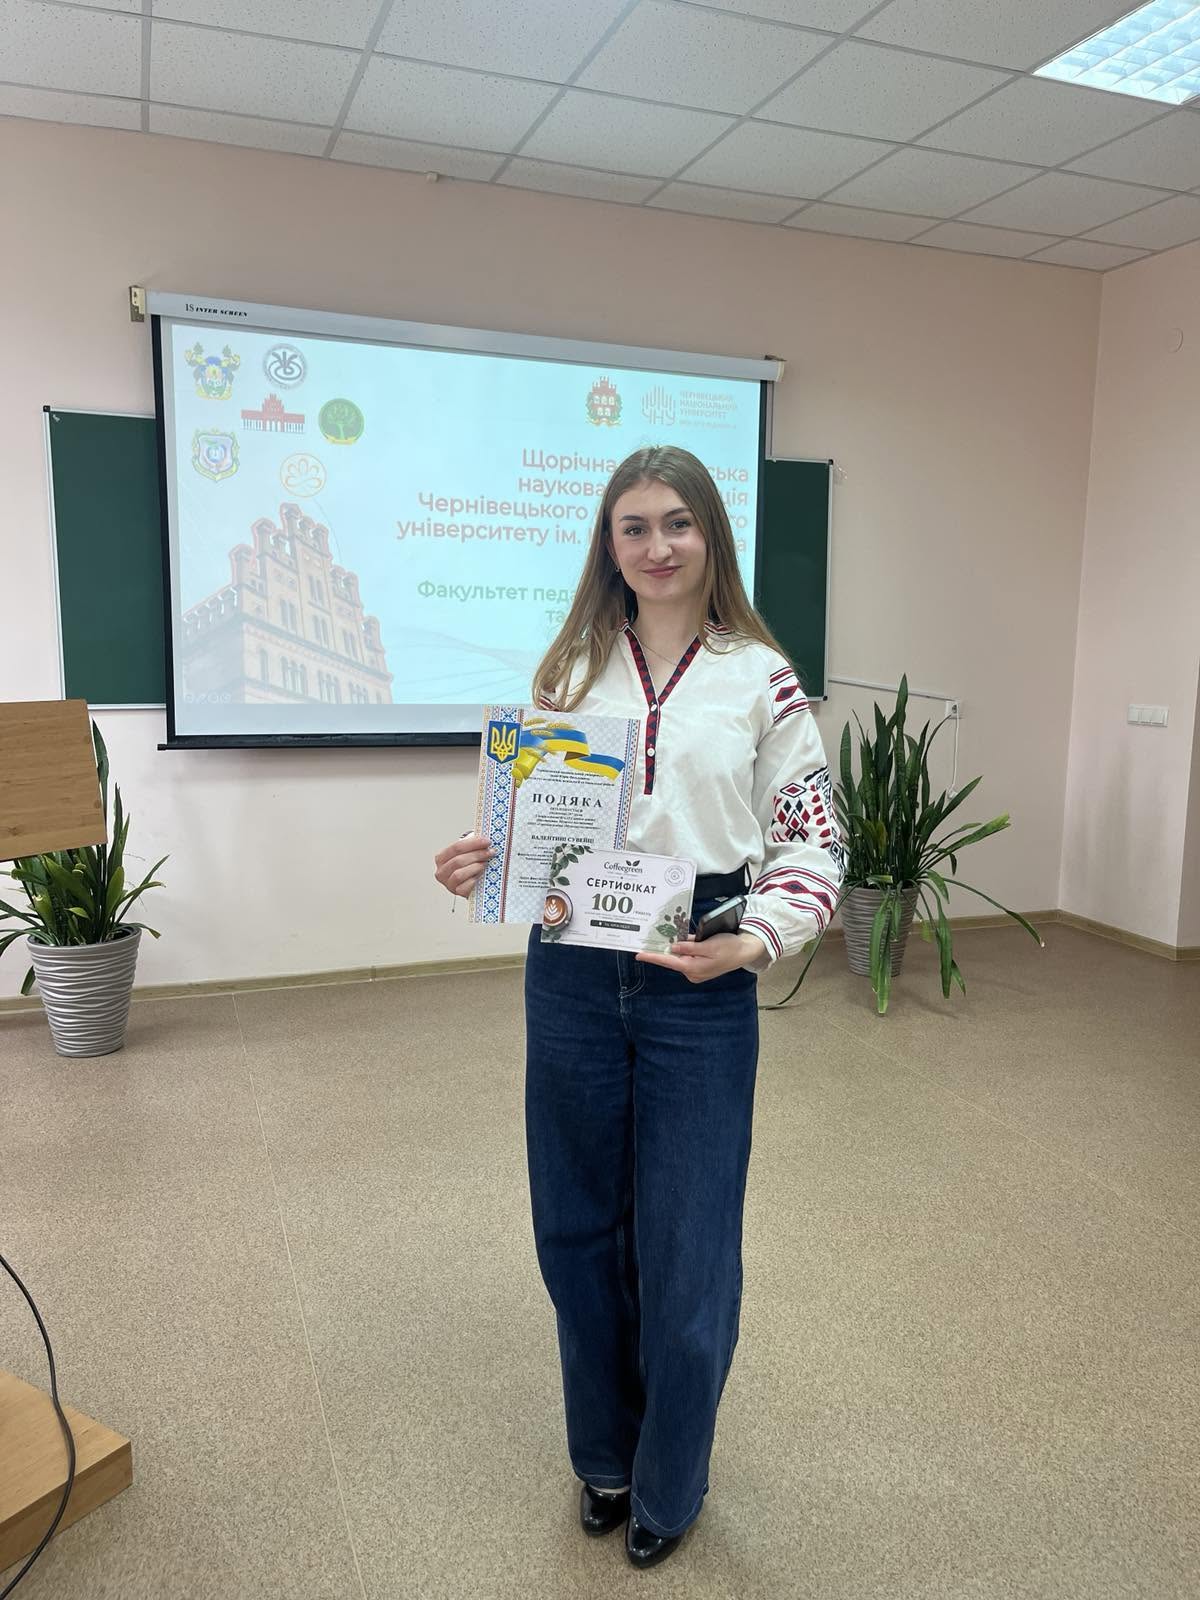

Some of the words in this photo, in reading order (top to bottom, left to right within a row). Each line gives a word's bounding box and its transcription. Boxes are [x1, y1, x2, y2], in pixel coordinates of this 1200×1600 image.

[196, 306, 218, 315] INTER
[220, 309, 248, 317] SCREEN
[522, 448, 616, 474] Щорічна
[518, 477, 605, 497] наукова
[418, 492, 588, 520] Чернівецького
[396, 517, 549, 546] університету
[555, 525, 581, 545] ім.
[417, 580, 528, 602] Факультет
[532, 793, 602, 808] ПОДЯКА
[604, 862, 643, 874] Coffeegreen
[586, 877, 657, 895] СЕРТИФІКАТ
[592, 893, 634, 914] 100
